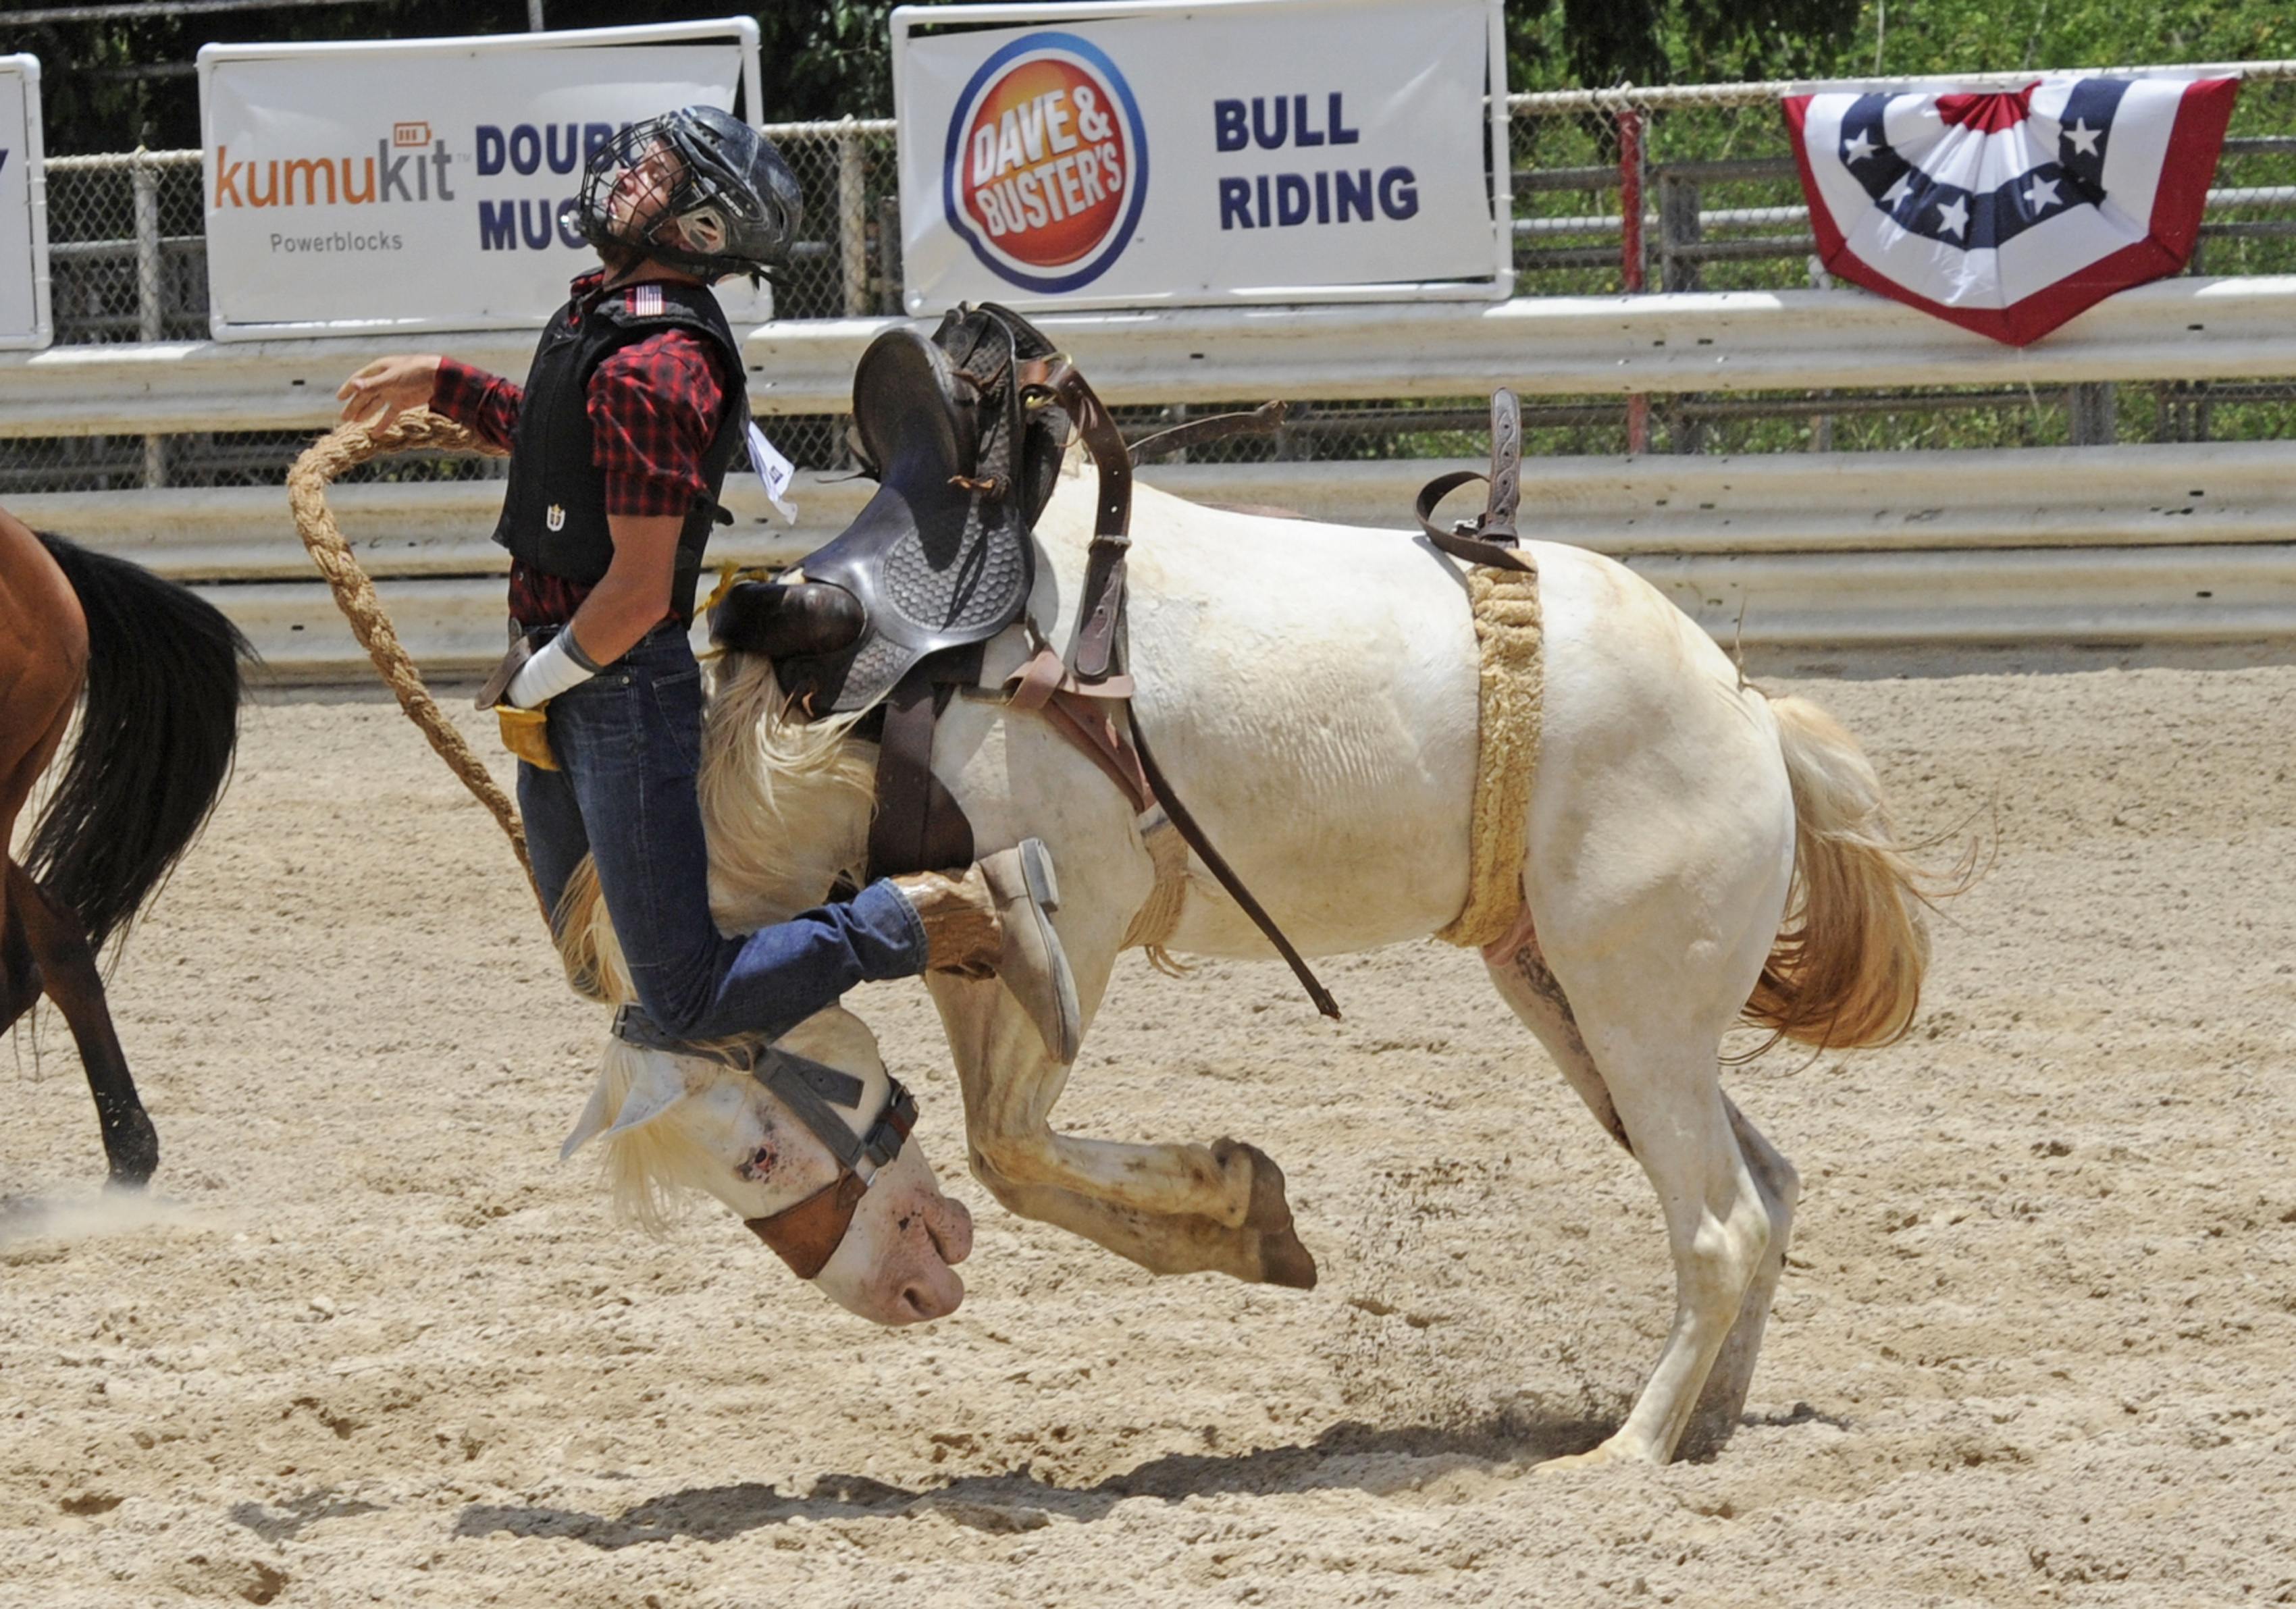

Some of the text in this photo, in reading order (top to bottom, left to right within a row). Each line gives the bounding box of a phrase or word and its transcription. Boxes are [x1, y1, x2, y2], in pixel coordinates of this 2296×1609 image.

[476, 122, 645, 176] DOUBL
[974, 85, 1113, 188] DAVE &
[1214, 92, 1359, 153] BULL
[215, 138, 454, 209] kumukit
[974, 142, 1122, 236] BUSTER'S
[1219, 165, 1419, 230] RIDING
[270, 232, 403, 253] Powerblocks
[479, 196, 591, 250] MUG
